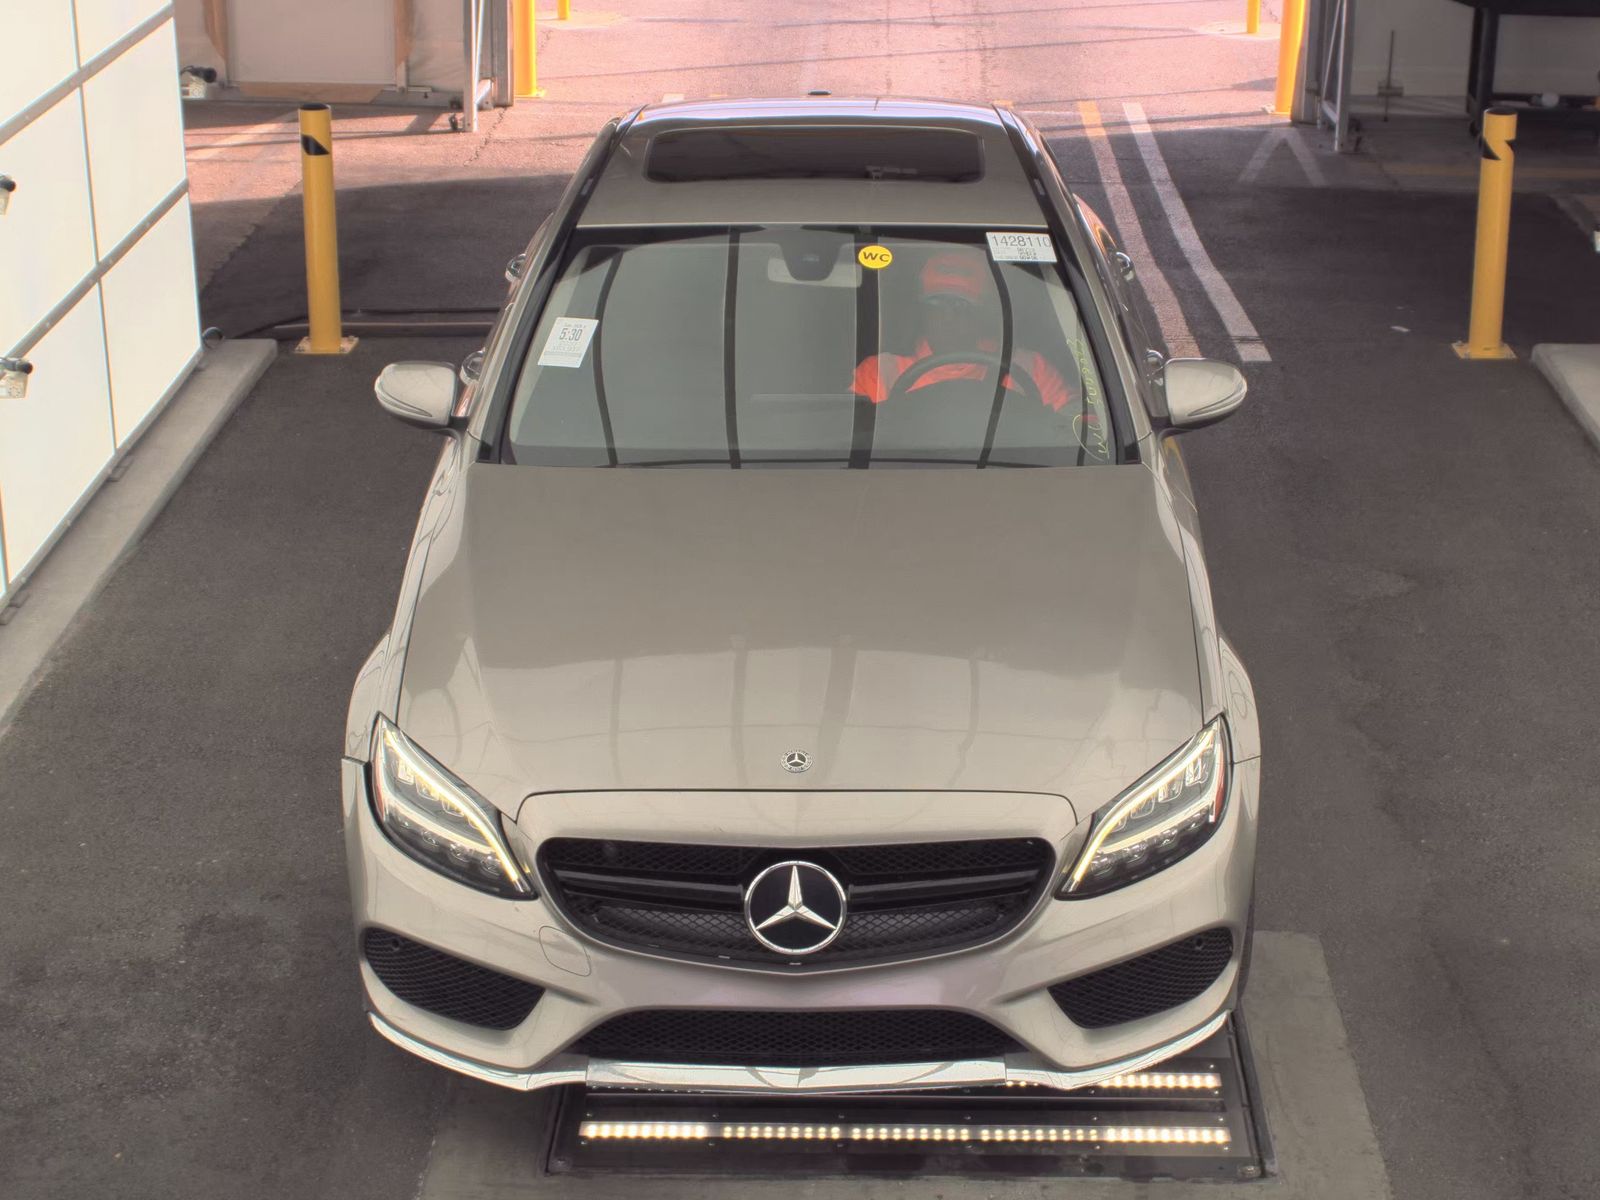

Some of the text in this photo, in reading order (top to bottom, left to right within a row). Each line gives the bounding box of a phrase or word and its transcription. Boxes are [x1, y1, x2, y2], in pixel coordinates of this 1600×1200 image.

[992, 234, 1052, 247] 1428110
[863, 251, 890, 262] WC
[559, 327, 583, 341] 5:30
